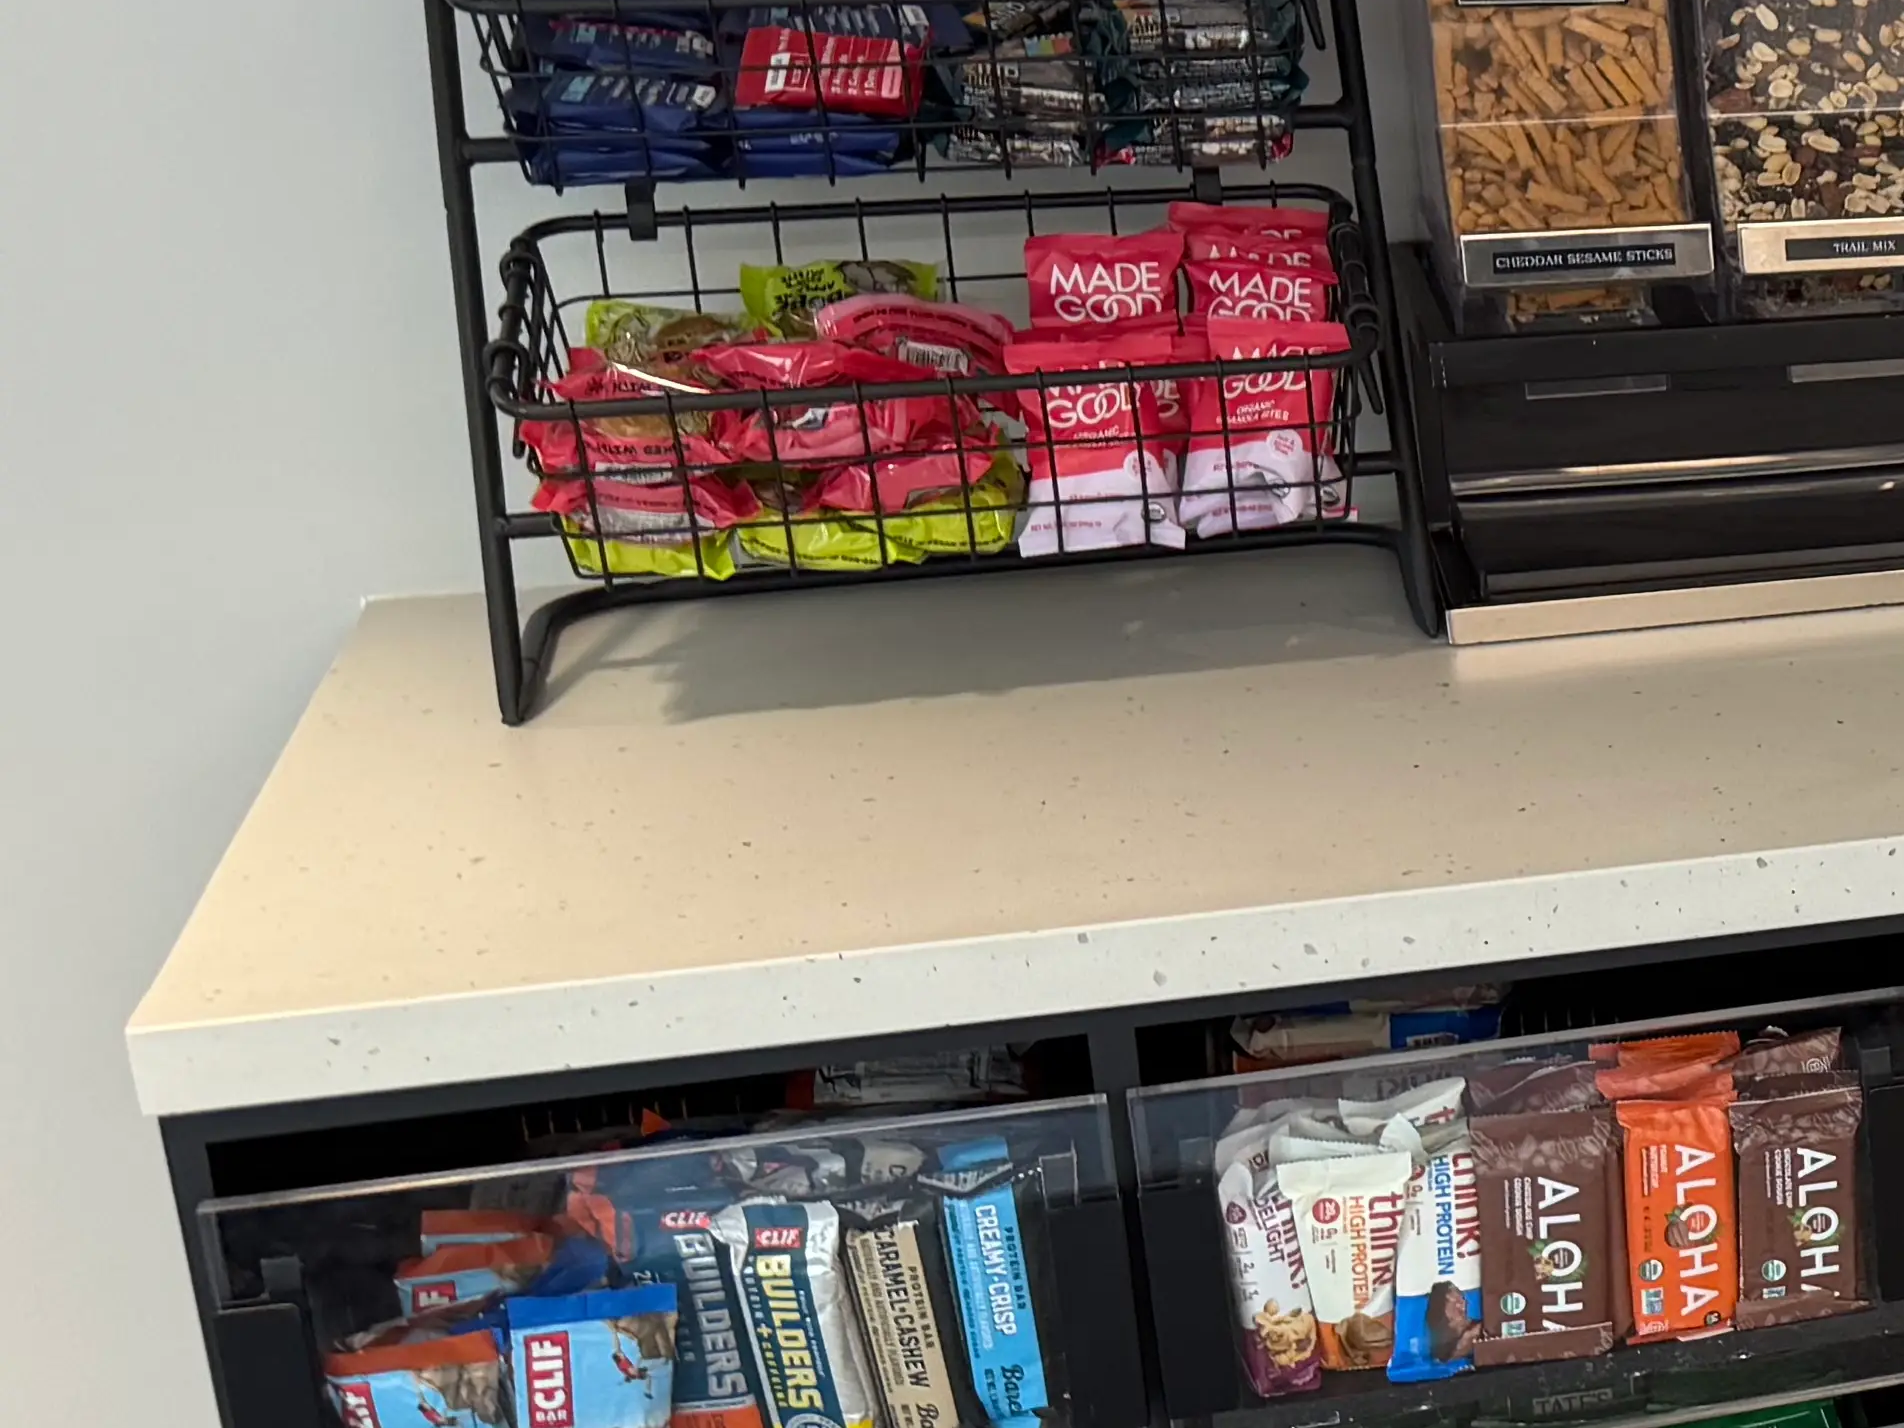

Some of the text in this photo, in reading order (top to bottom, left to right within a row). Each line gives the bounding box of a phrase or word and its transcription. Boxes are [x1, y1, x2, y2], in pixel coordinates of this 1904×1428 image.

[1496, 246, 1674, 271] CHEDDAR SESAME STICKS
[1833, 239, 1897, 253] TRAIL MIX
[1050, 261, 1161, 294] MADE
[1208, 270, 1312, 308] MADE
[757, 1230, 798, 1247] CLIF
[1432, 1154, 1455, 1276] HIGH PROTEIN
[1673, 1144, 1721, 1317] ALOHA
[673, 1234, 748, 1397] BUILDERS
[757, 1254, 824, 1412] BUILDERS
[531, 1339, 568, 1411] CLIF
